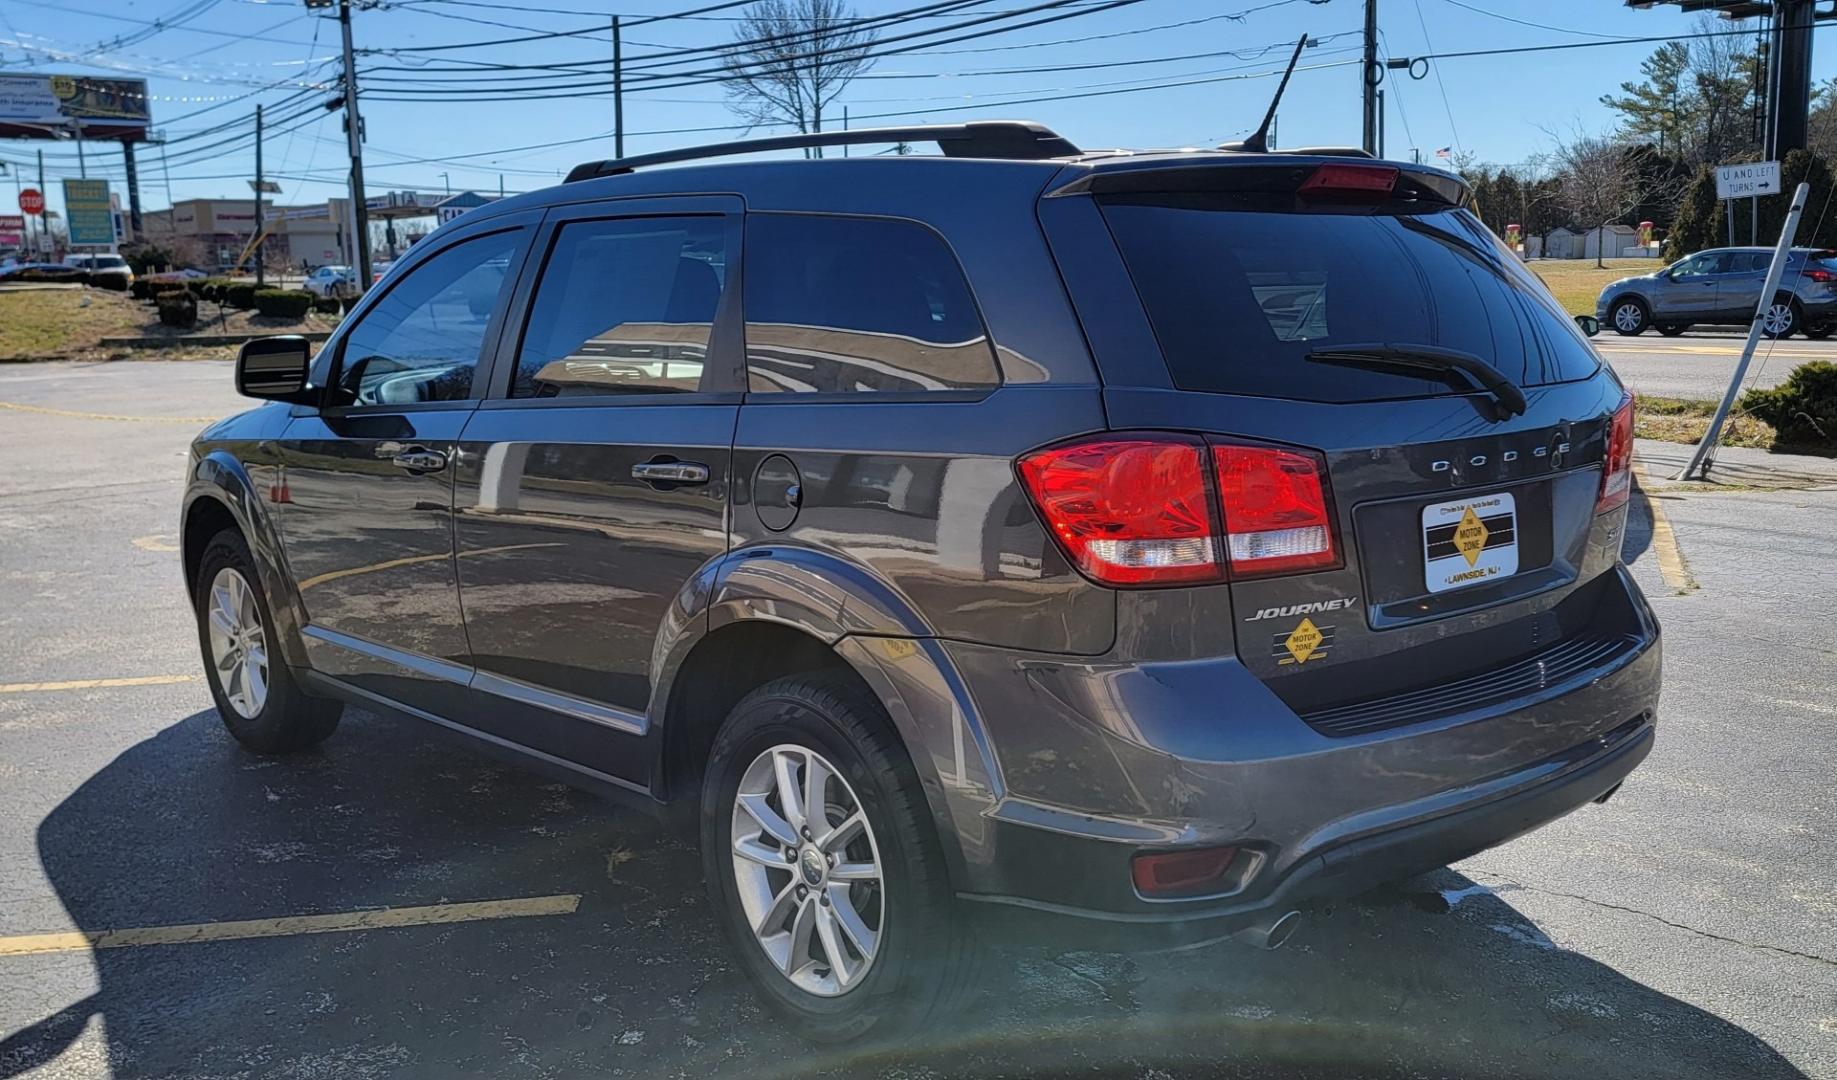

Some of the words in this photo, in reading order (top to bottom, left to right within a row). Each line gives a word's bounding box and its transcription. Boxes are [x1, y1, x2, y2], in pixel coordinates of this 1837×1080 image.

[1723, 168, 1730, 180] U
[1734, 169, 1753, 179] AND
[1756, 166, 1775, 177] LEFT
[1729, 182, 1754, 193] TURNS
[20, 196, 43, 208] STOP
[1459, 526, 1482, 540] MOTOR
[1463, 539, 1480, 552] ZONE
[1244, 596, 1358, 622] JOURNEY
[1292, 633, 1317, 643] MOTOR
[1294, 642, 1313, 652] ZONE
